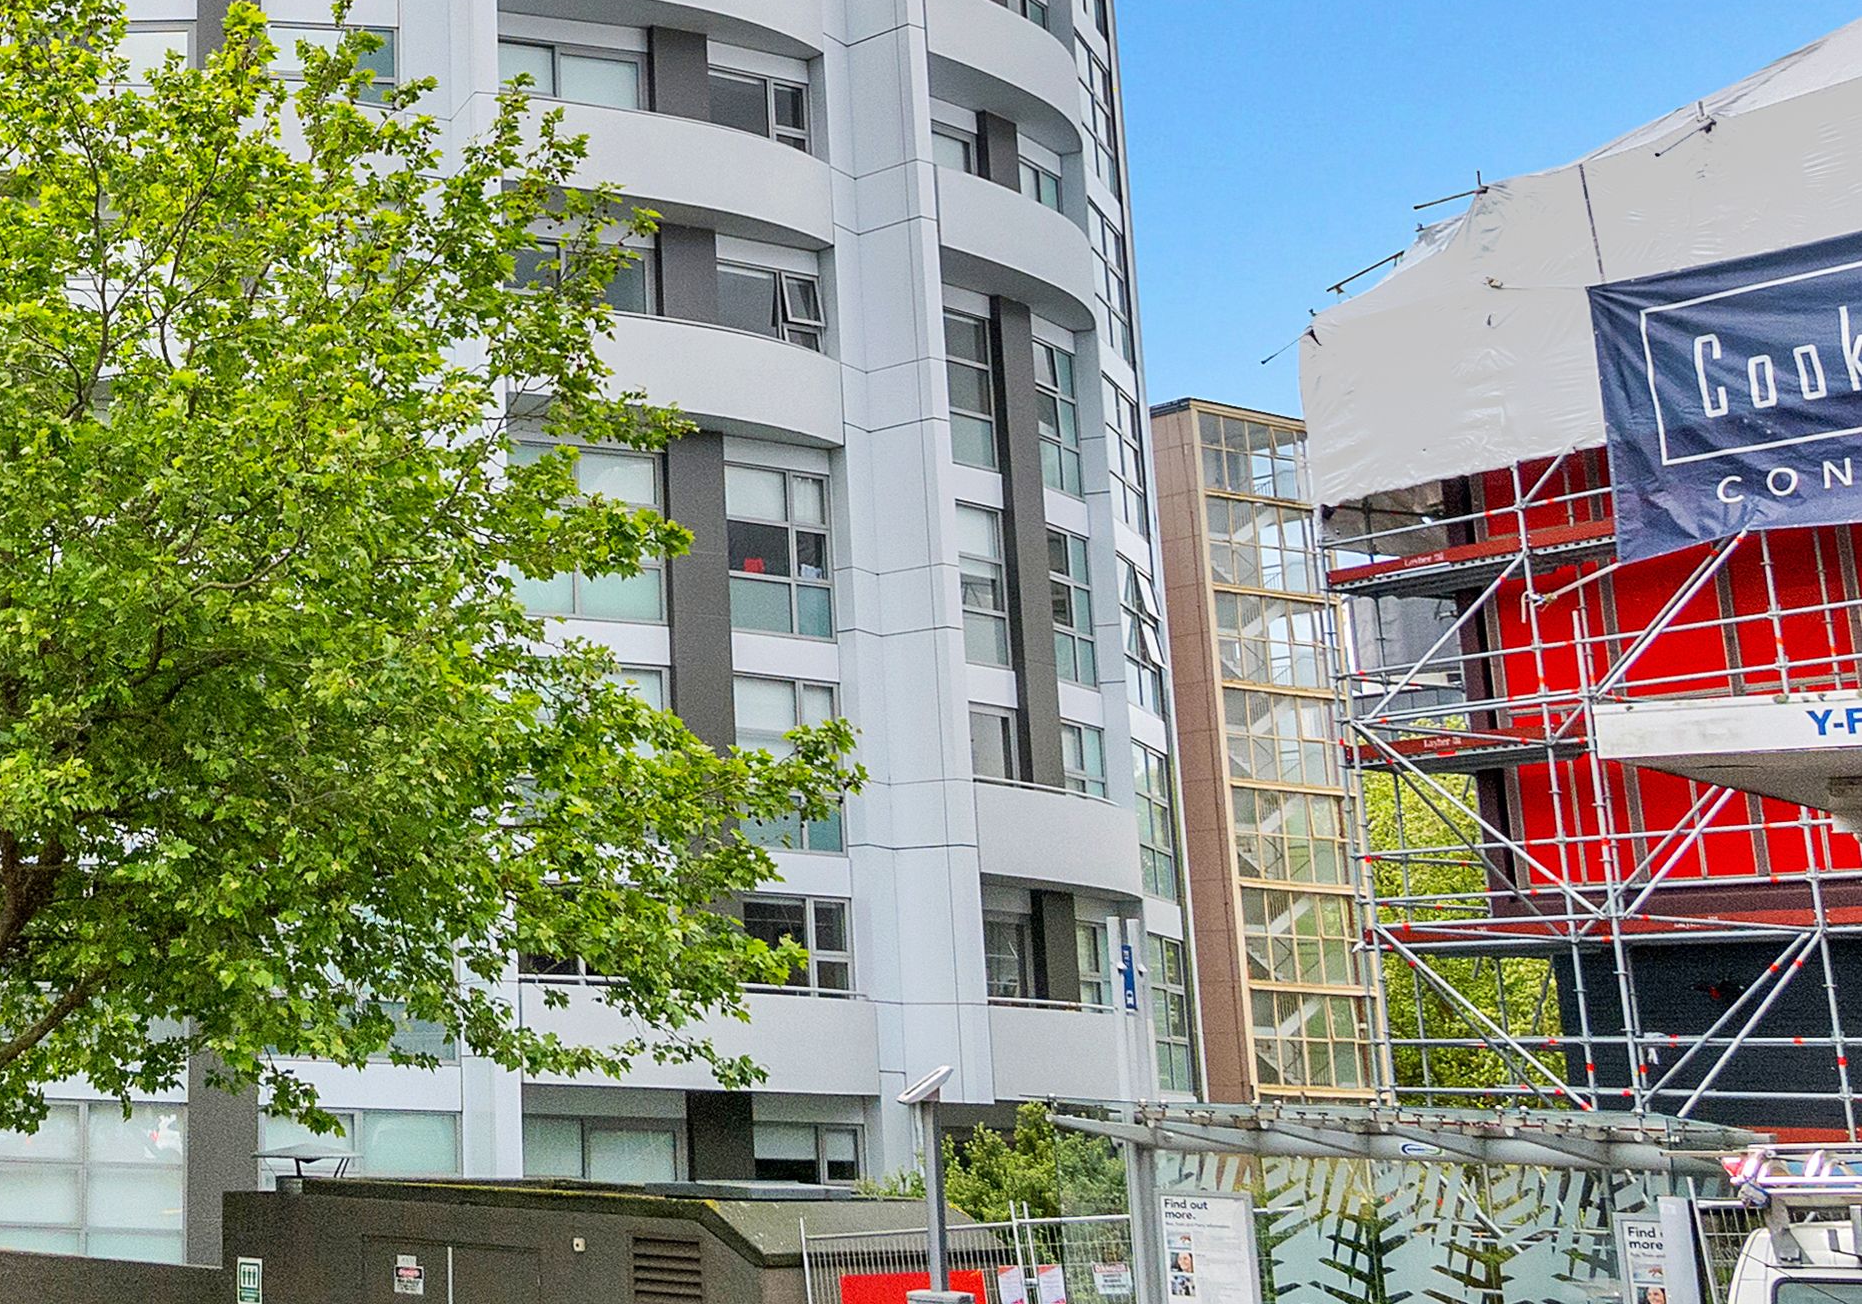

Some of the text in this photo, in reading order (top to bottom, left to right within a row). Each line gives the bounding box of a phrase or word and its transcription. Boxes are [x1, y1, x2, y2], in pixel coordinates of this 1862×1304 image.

[1693, 305, 1862, 418] Cook
[1716, 457, 1853, 503] CON
[1164, 1198, 1208, 1210] Find out
[1165, 1211, 1196, 1220] more.
[1628, 1226, 1656, 1238] Find
